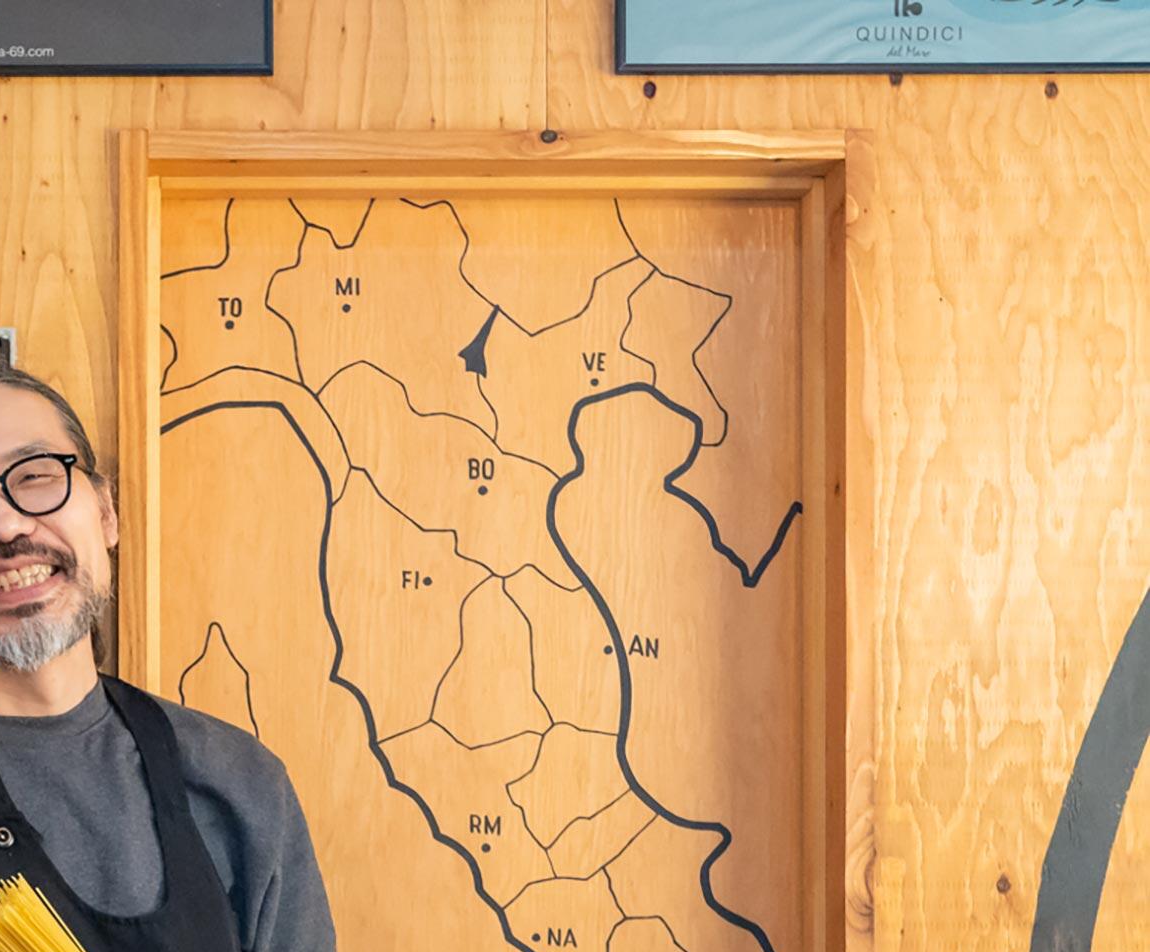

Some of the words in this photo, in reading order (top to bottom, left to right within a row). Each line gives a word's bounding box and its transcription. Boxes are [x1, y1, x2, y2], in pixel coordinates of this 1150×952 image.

[856, 26, 963, 42] QUINDICI
[886, 46, 901, 57] del
[905, 46, 931, 58] Mare
[335, 277, 361, 297] MI
[218, 297, 243, 318] TO
[582, 352, 607, 372] VE
[468, 457, 495, 481] BO
[401, 571, 420, 590] FI
[629, 635, 659, 659] AN
[469, 813, 501, 836] RM
[547, 927, 578, 949] NA
